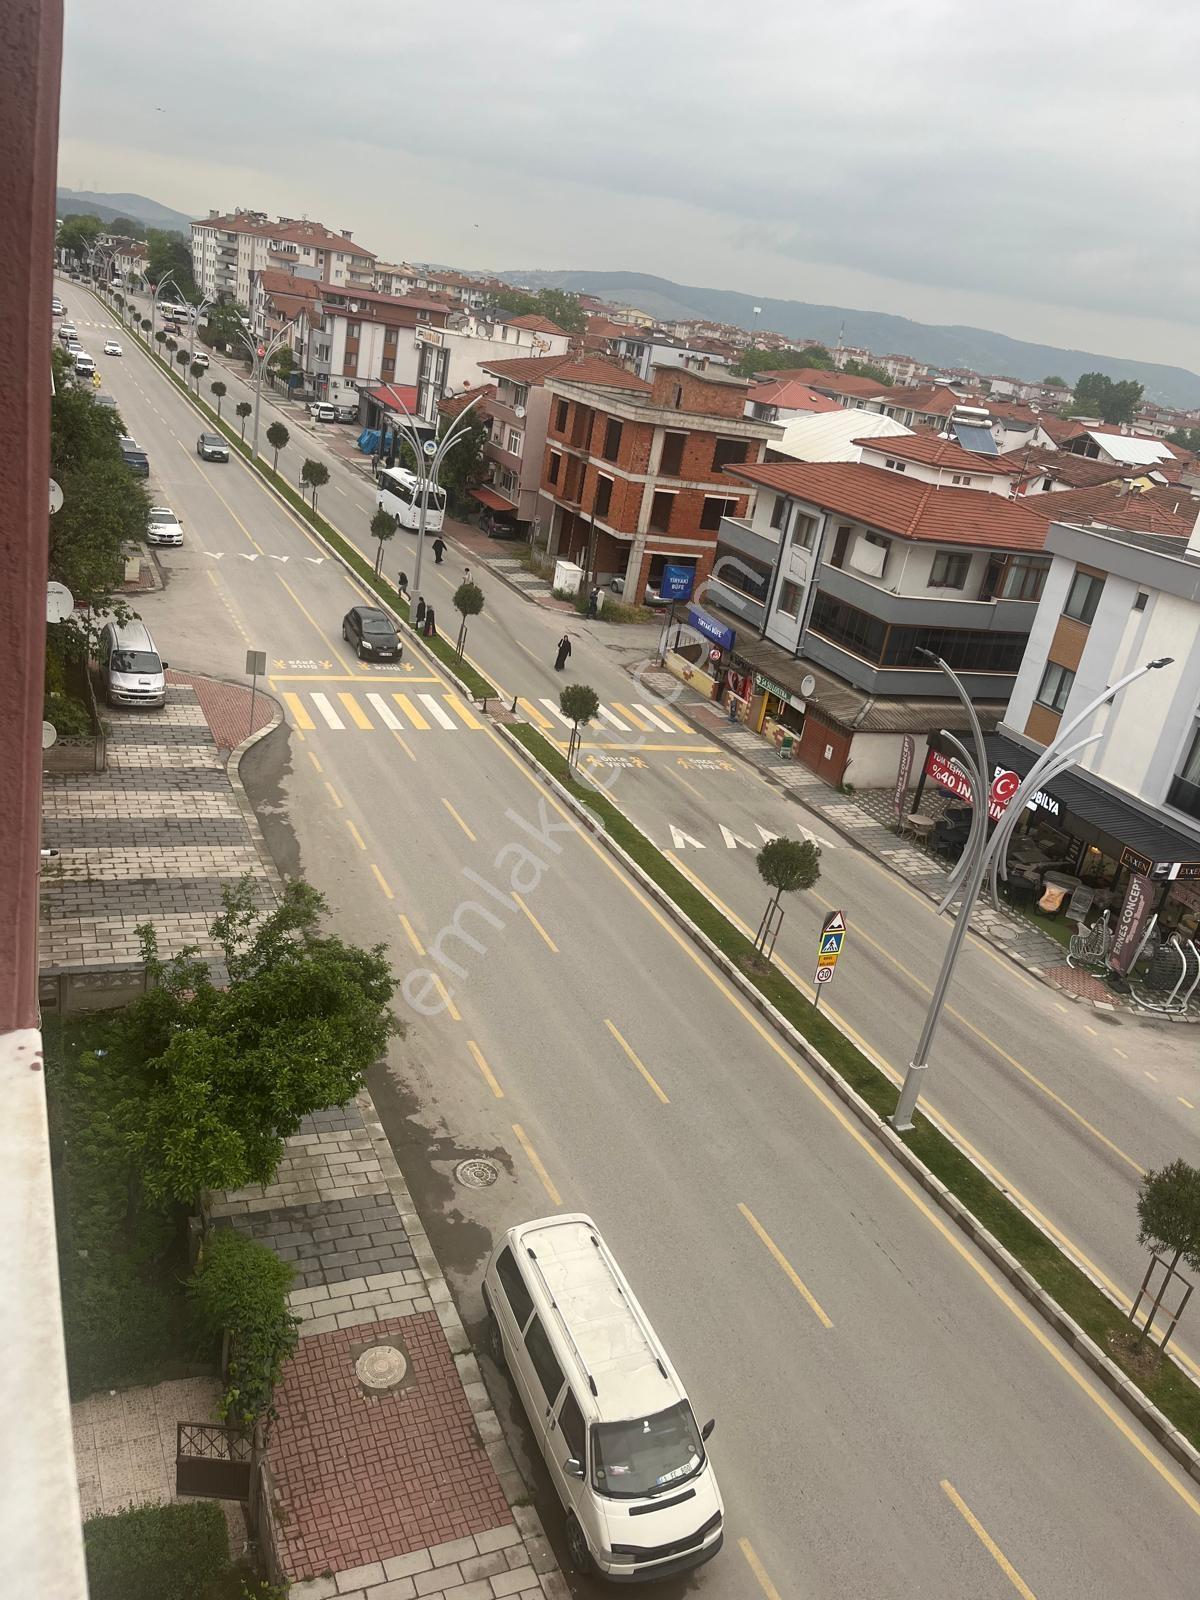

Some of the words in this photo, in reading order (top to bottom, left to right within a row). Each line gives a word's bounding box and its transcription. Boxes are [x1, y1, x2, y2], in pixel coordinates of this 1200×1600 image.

[932, 764, 956, 788] %40
[1030, 790, 1059, 816] OBİLYA
[1179, 865, 1200, 875] EXXE
[1113, 924, 1129, 954] ERNES
[1122, 878, 1142, 924] CONCEPT
[820, 970, 829, 979] 30
